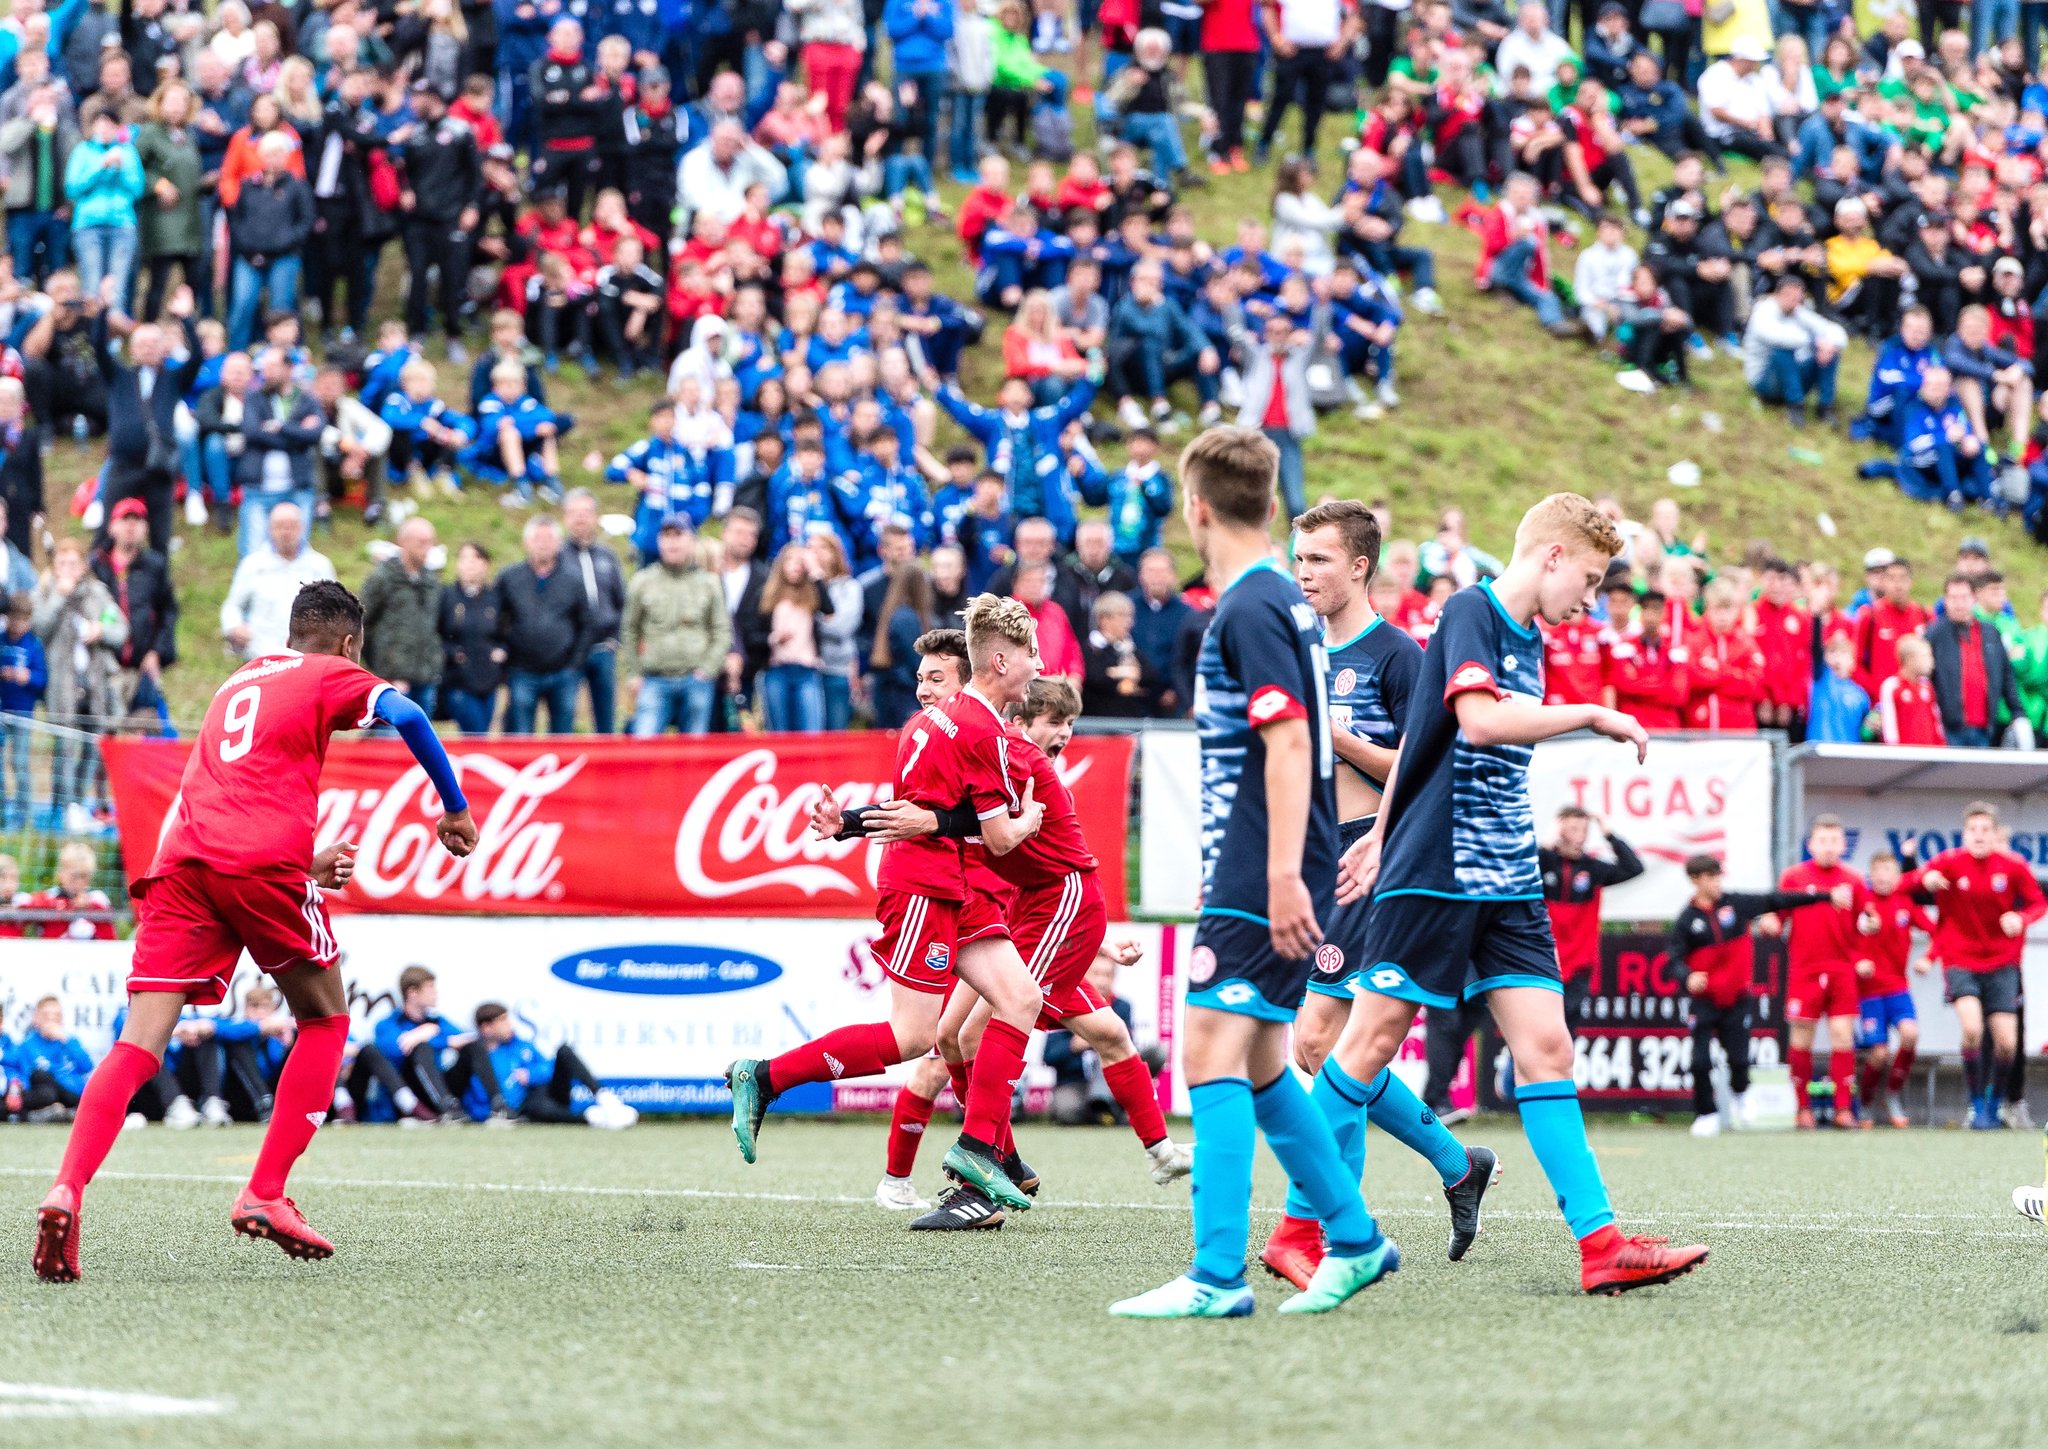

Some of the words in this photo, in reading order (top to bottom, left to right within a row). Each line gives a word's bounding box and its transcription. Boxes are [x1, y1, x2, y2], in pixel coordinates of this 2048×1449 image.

[219, 684, 262, 763] 9
[901, 727, 930, 784] 7
[1570, 778, 1727, 817] TIGAS
